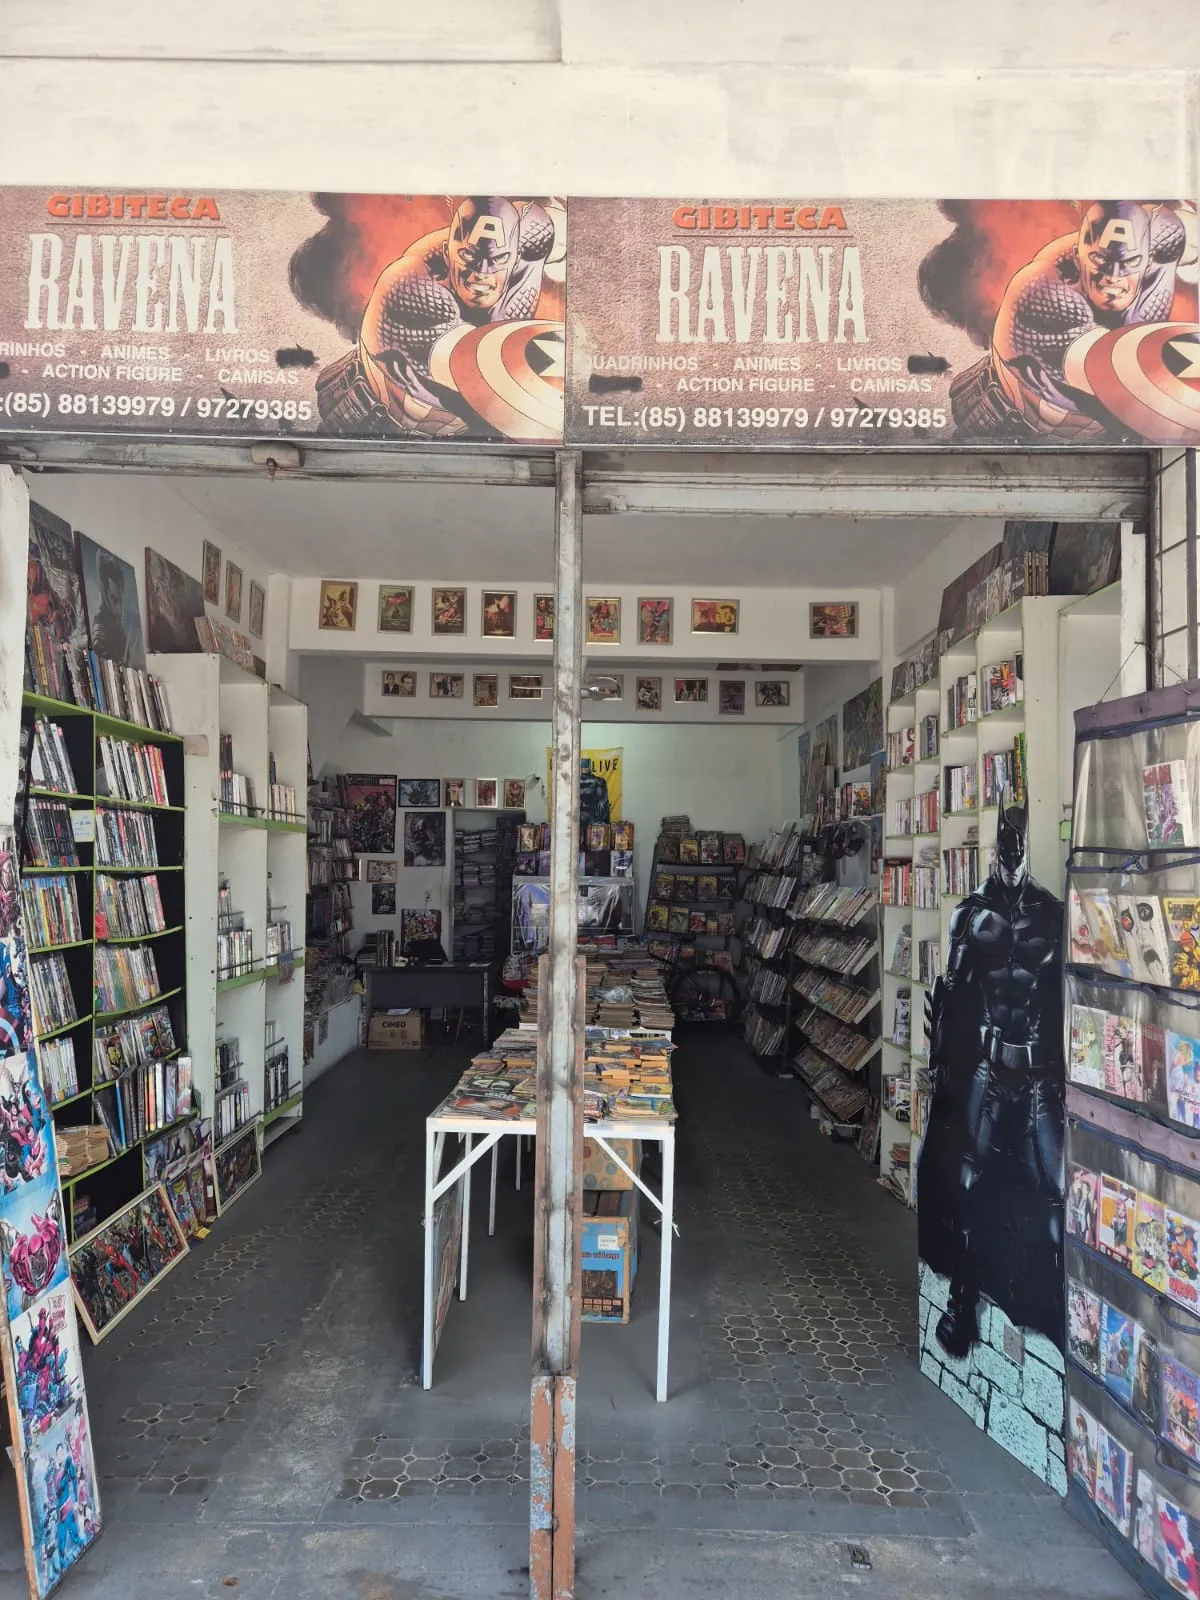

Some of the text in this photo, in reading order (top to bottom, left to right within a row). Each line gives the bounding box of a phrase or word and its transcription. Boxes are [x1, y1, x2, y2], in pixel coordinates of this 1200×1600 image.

[47, 194, 221, 221] GIBITECA
[671, 206, 848, 231] GIBITECA
[24, 232, 239, 334] RAVENA
[654, 245, 870, 344] RAVENA
[0, 342, 66, 358] RINHOS
[101, 345, 170, 361] ANIMES
[205, 347, 270, 363] LIVROS
[587, 355, 699, 371] UADRINHOS
[733, 356, 801, 372] ANIMES
[836, 357, 902, 372] LIVROS
[42, 363, 110, 381] ACTION
[116, 366, 183, 382] FIGURE
[217, 368, 299, 385] CAMISAS
[676, 377, 743, 392] ACTION
[748, 378, 815, 392] FIGURE
[850, 378, 932, 393] CAMISAS
[57, 393, 175, 417] 88139979
[197, 398, 312, 420] 97279385
[582, 405, 686, 432] TEL:(85)
[693, 407, 808, 428] 88139979
[830, 408, 947, 428] 97279385
